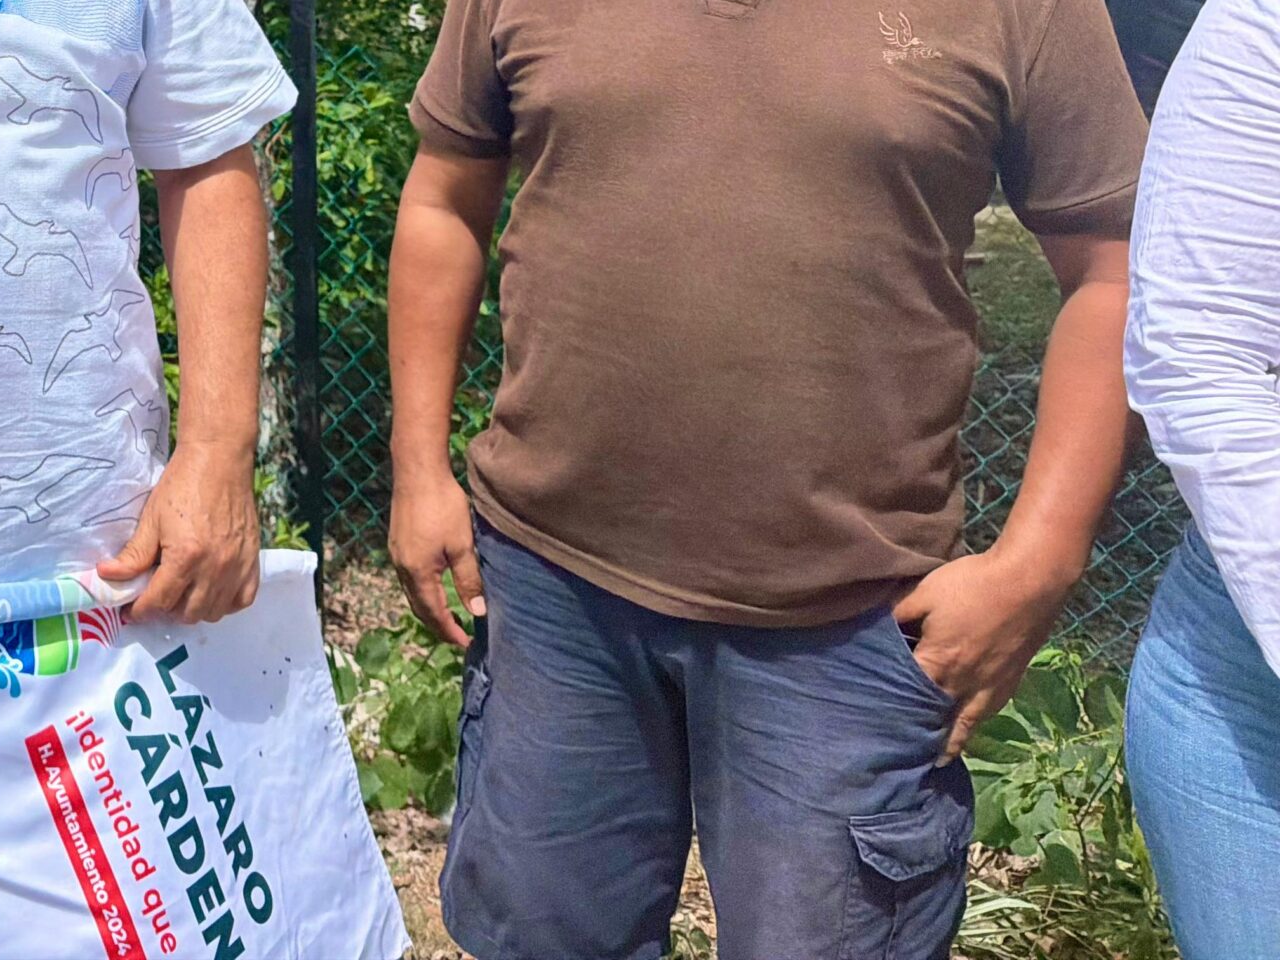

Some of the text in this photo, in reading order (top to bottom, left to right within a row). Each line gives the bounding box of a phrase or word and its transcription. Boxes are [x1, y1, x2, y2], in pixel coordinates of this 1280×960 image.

[37, 743, 133, 956] H. Ayuntamiento 2024
[114, 681, 246, 960] CÁRDEN
[155, 643, 273, 925] LÁZARO
[141, 888, 177, 955] que
